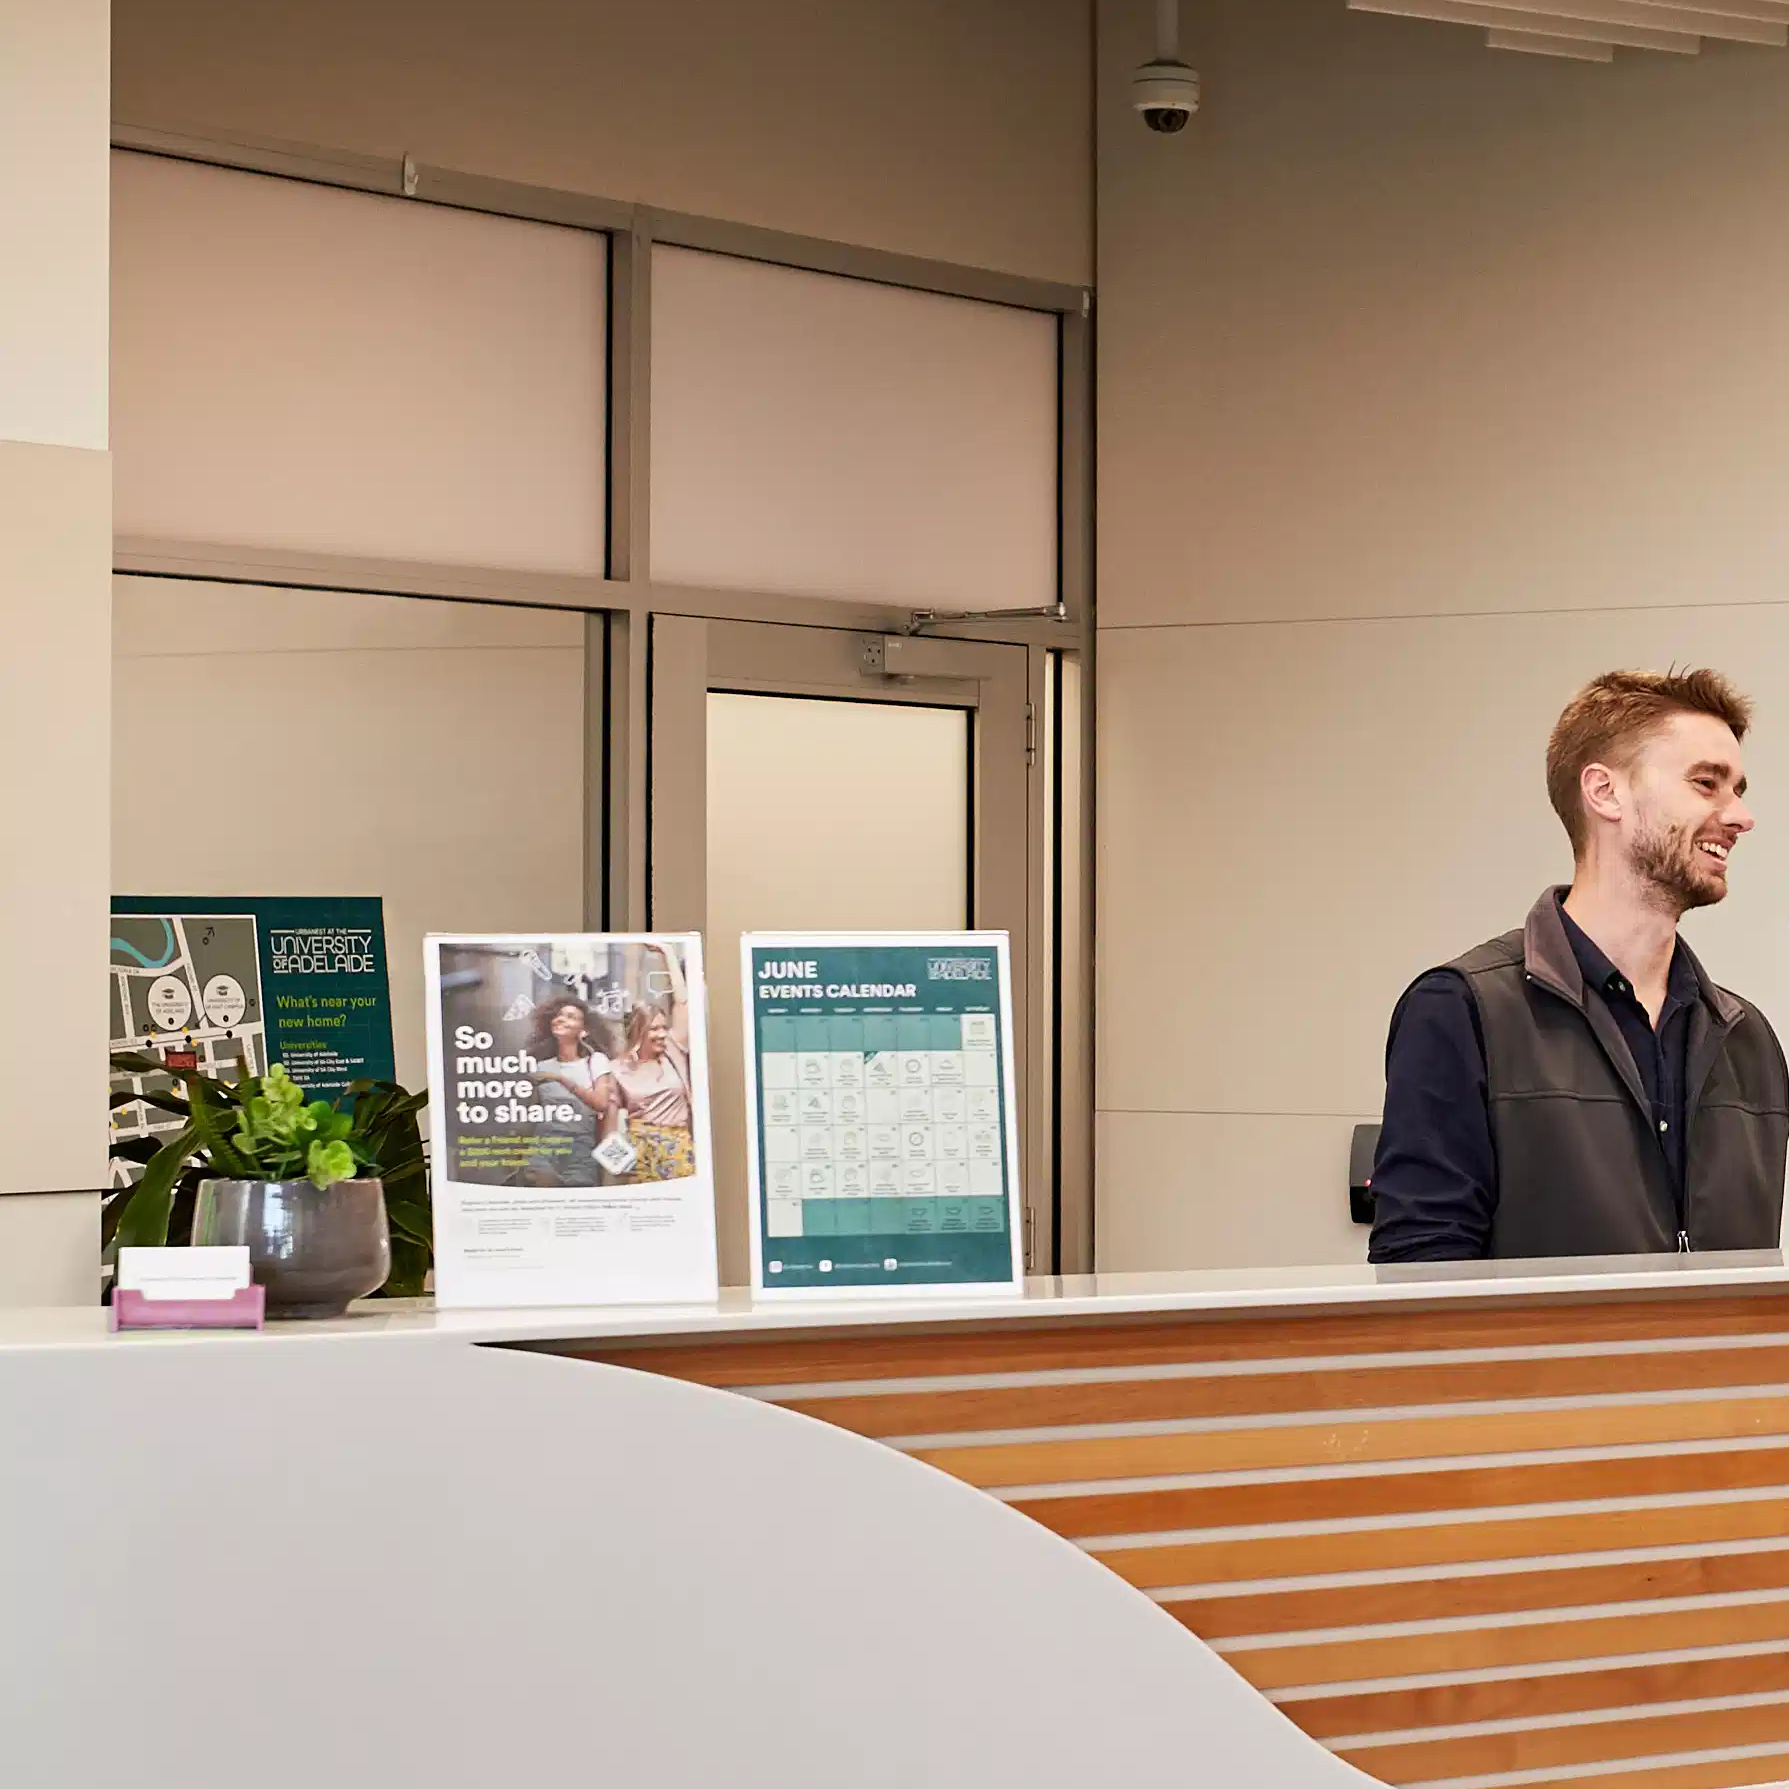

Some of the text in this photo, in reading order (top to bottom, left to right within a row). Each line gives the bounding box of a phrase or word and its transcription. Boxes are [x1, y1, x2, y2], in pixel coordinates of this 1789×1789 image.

[270, 936, 372, 955] UNIVERSITY
[272, 954, 375, 973] OF ADELAIDE
[757, 960, 818, 980] JUNE
[758, 983, 917, 999] EVENTS CALENDAR
[276, 995, 377, 1010] What's near your
[278, 1014, 347, 1028] new home?
[454, 1025, 494, 1050] So
[456, 1049, 538, 1074] much
[456, 1079, 533, 1099] more
[456, 1098, 583, 1124] to share.
